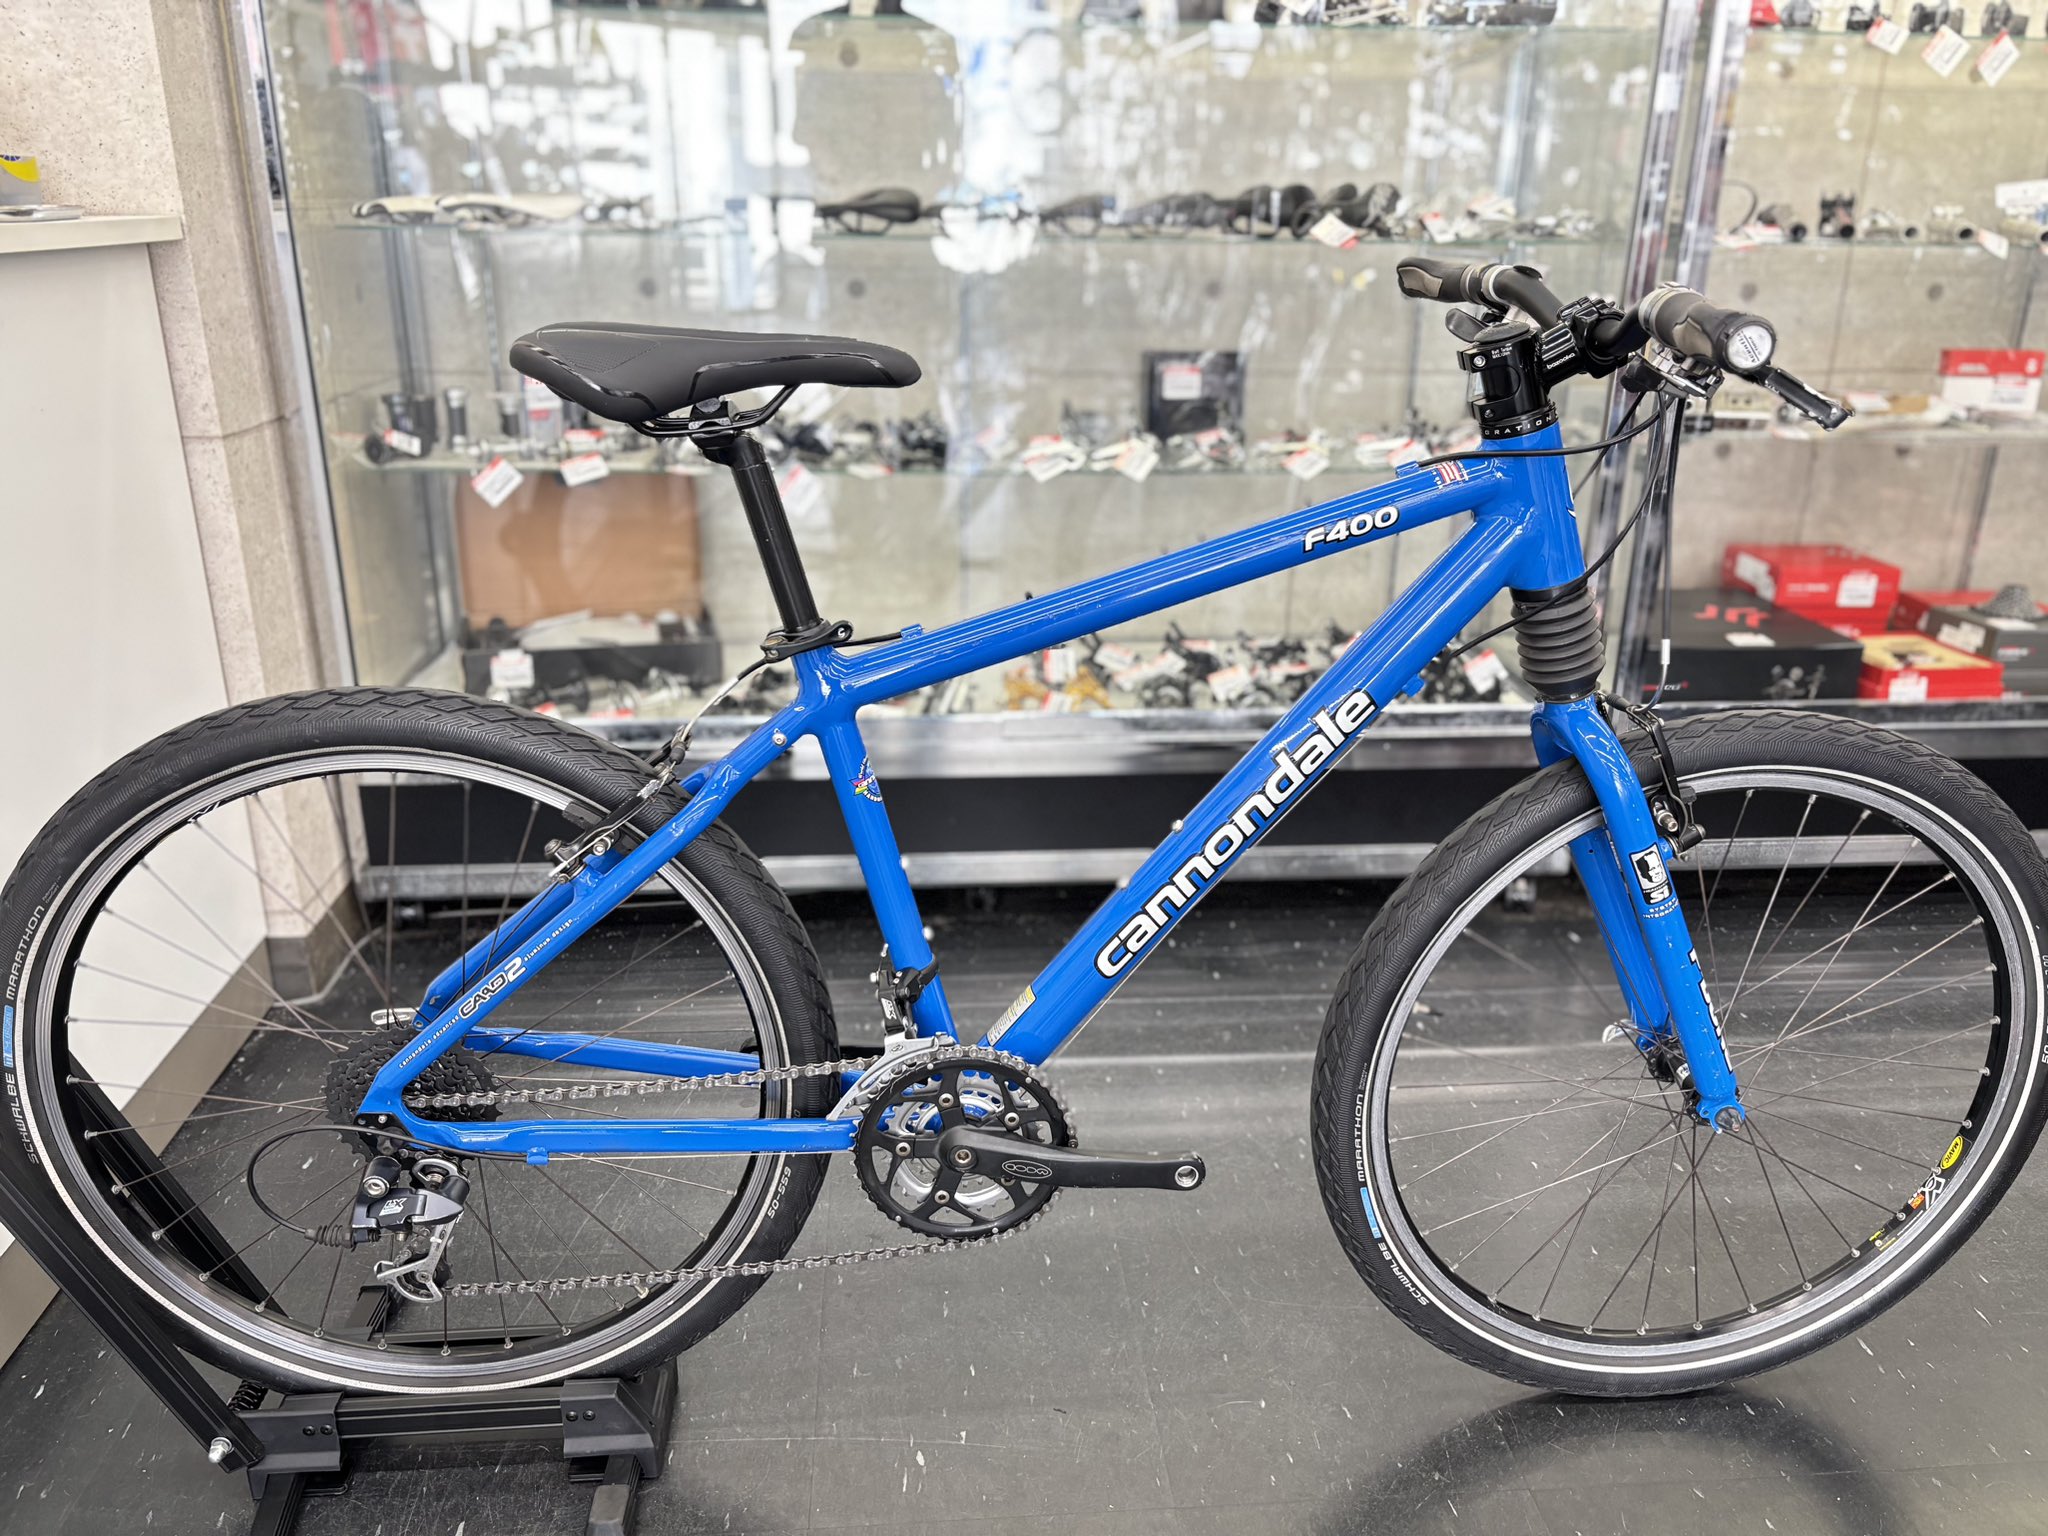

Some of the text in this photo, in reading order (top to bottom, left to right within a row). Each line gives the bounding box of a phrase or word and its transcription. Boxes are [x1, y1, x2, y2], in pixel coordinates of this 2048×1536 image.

[1303, 505, 1400, 553] F400
[1094, 688, 1378, 979] cannondale
[6, 905, 45, 1000] MARATHON
[5, 1072, 39, 1165] SCHWALBE
[1354, 1093, 1365, 1181] MARATHON
[767, 1166, 792, 1219] 50-559
[1378, 1242, 1430, 1306] SCHWALBE
